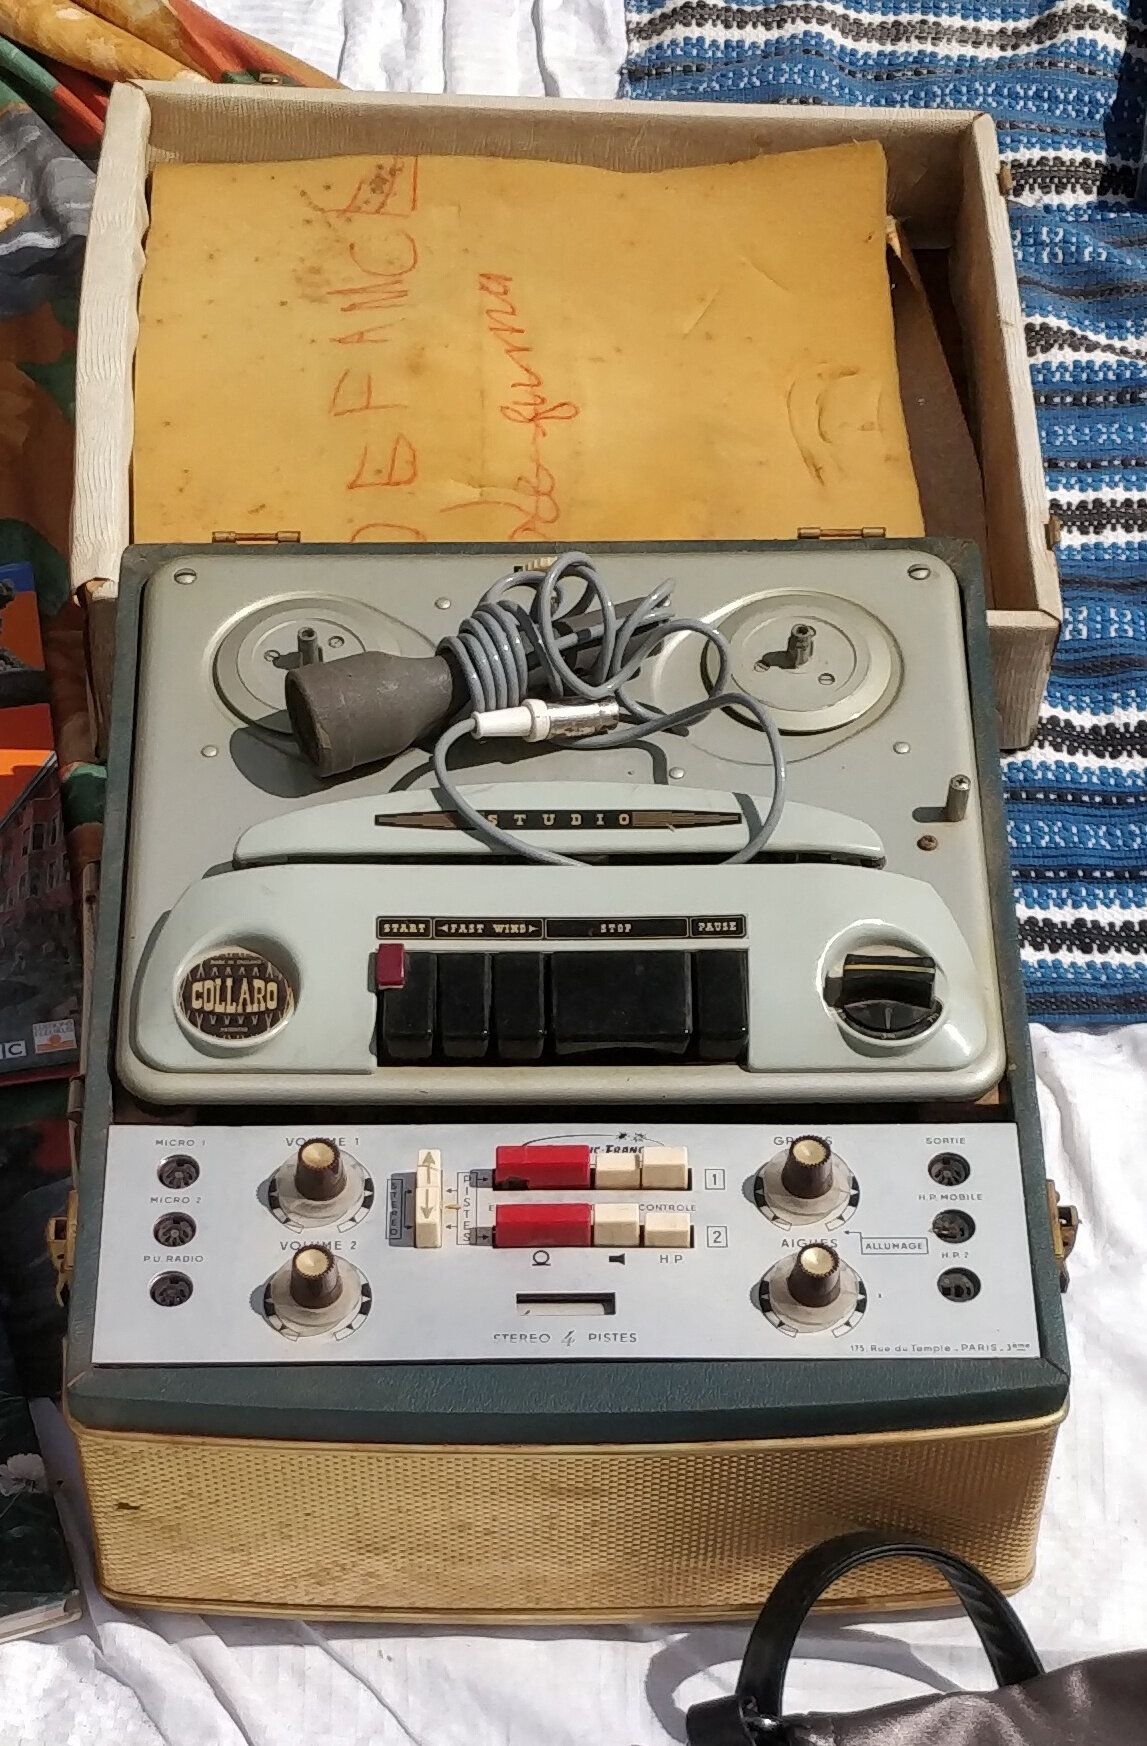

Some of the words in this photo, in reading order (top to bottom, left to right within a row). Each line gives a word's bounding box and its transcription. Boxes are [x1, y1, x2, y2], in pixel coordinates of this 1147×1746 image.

[487, 813, 631, 826] STUDIO
[383, 923, 427, 934] START
[450, 923, 485, 934] FAST
[493, 923, 527, 934] WIND
[600, 923, 632, 934] STOP
[697, 921, 737, 932] PAUSE
[191, 977, 278, 1014] COLLARO
[155, 1138, 196, 1147] MICRO
[285, 1136, 347, 1148] VOME
[354, 1137, 360, 1147] 1
[773, 1135, 834, 1147] GRS
[925, 1136, 967, 1146] SORTIE
[711, 1173, 718, 1186] 1
[150, 1195, 191, 1205] MICRO
[195, 1196, 203, 1205] 2
[940, 1192, 983, 1202] MOBILE
[638, 1203, 696, 1212] CONTROLE
[712, 1230, 723, 1244] 2
[279, 1239, 343, 1251] VOME
[349, 1240, 358, 1251] 2
[865, 1242, 923, 1251] ALLUMAGE
[166, 1254, 204, 1263] RADIO
[493, 1332, 551, 1344] STEREO
[560, 1329, 576, 1347] 4
[588, 1332, 637, 1343] PISTES
[870, 1344, 891, 1352] Rue
[894, 1344, 908, 1352] du
[911, 1343, 951, 1353] Temple
[961, 1343, 997, 1352] PARIS
